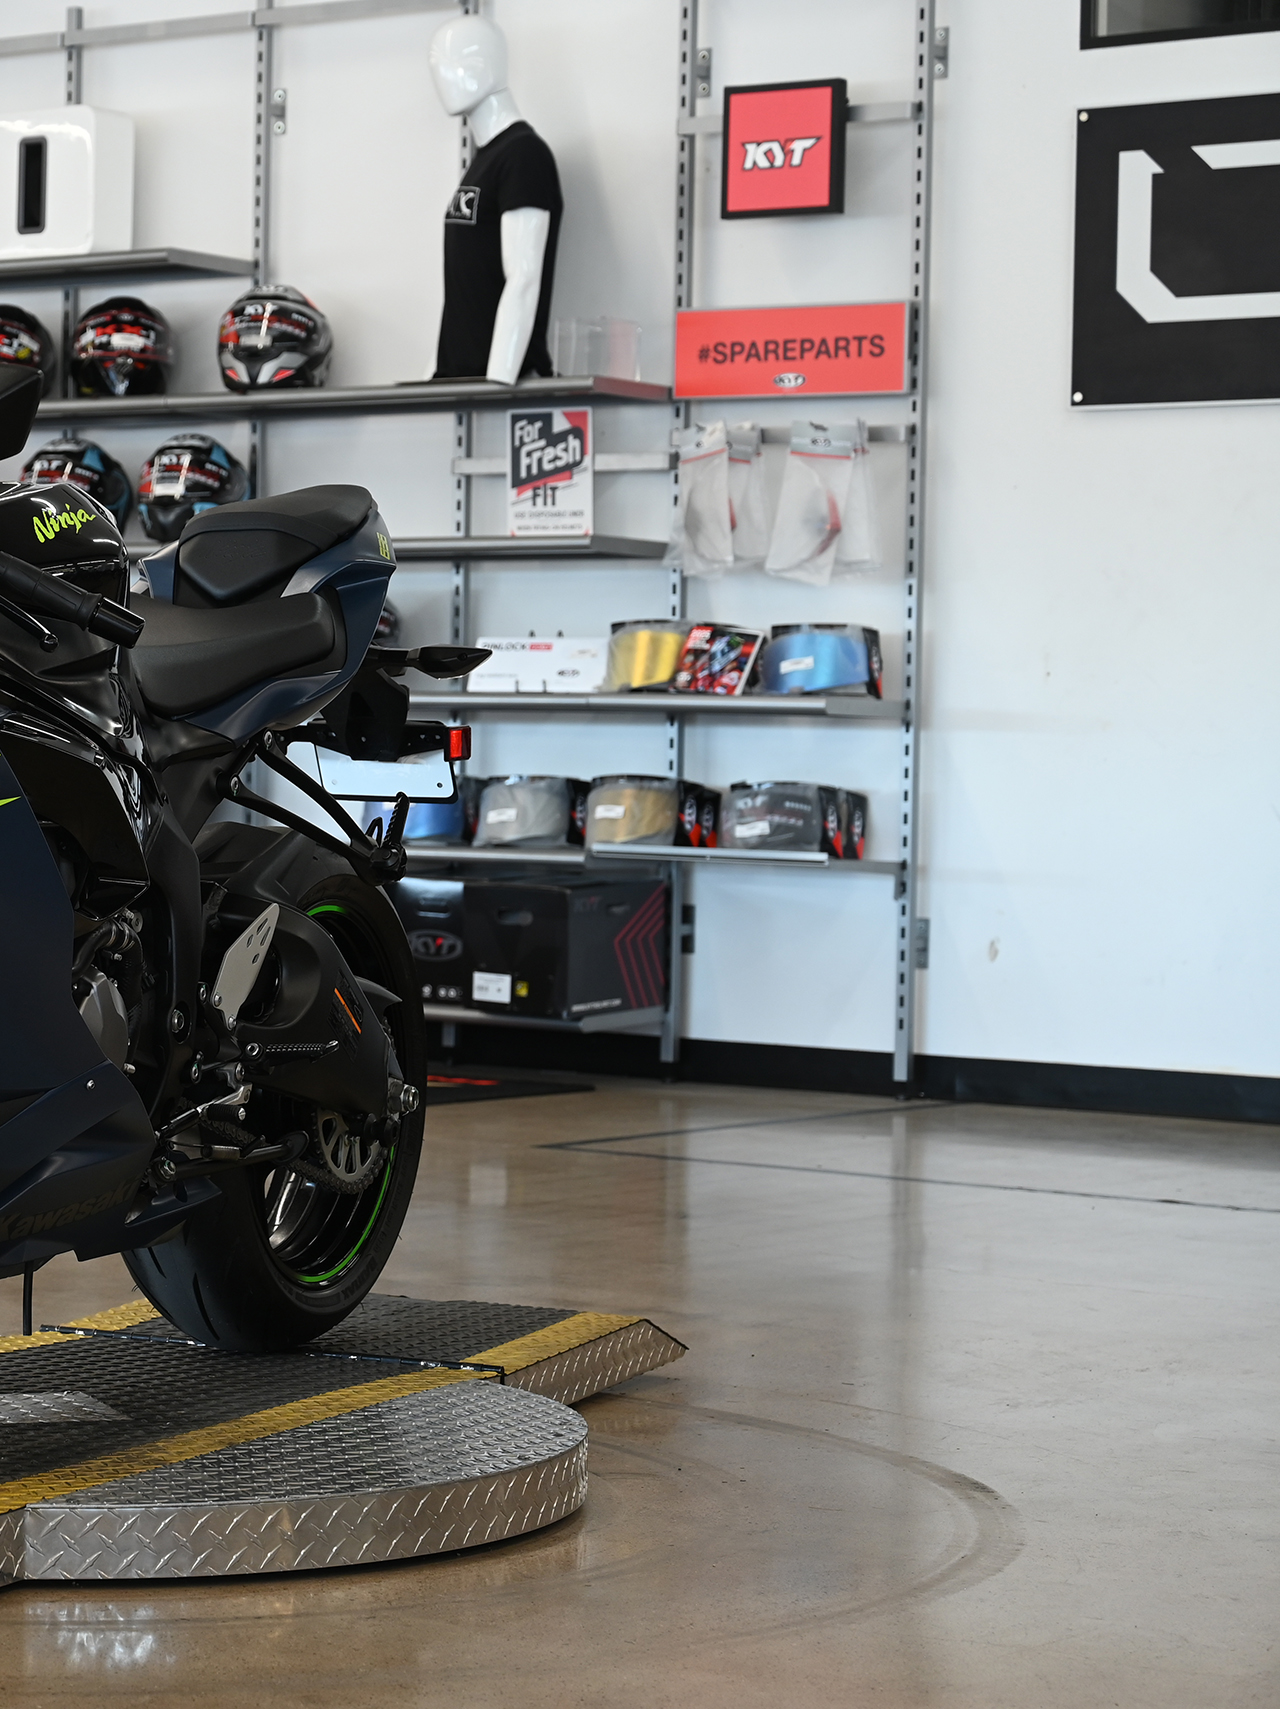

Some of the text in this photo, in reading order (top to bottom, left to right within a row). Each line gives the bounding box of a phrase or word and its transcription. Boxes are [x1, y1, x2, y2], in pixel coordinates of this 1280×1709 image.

[741, 136, 822, 171] KYT
[698, 334, 886, 365] #SPAREPARTS
[514, 419, 543, 447] For
[520, 434, 582, 479] Fresh
[532, 484, 559, 507] FIT
[32, 503, 97, 543] Ninja
